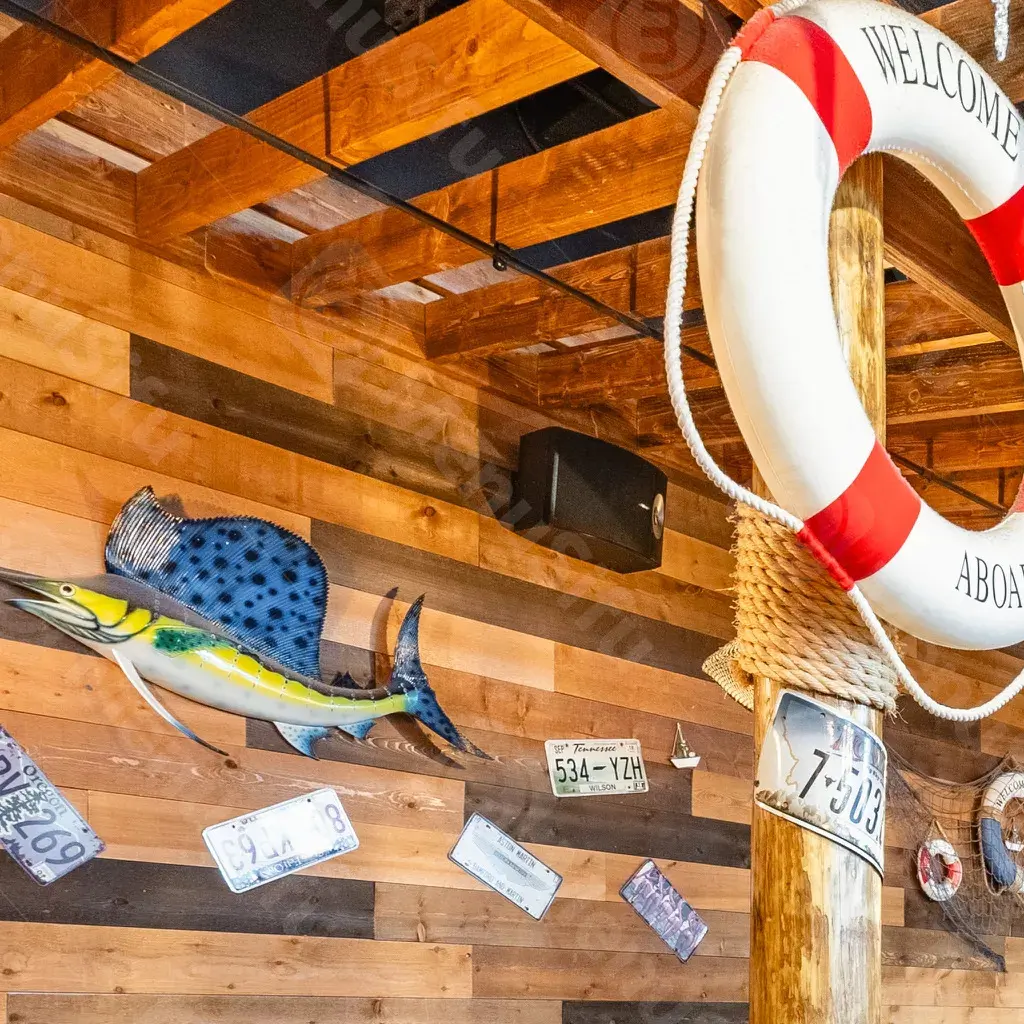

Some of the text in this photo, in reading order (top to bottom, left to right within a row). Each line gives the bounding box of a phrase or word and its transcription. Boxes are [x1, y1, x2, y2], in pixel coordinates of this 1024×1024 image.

[860, 24, 1021, 162] WELCOME
[572, 743, 617, 754] Tennessee
[588, 784, 617, 792] WILSON
[13, 808, 86, 866] 269
[496, 835, 516, 852] ASTON
[516, 850, 537, 869] MARTIN
[505, 888, 525, 904] MARTIN
